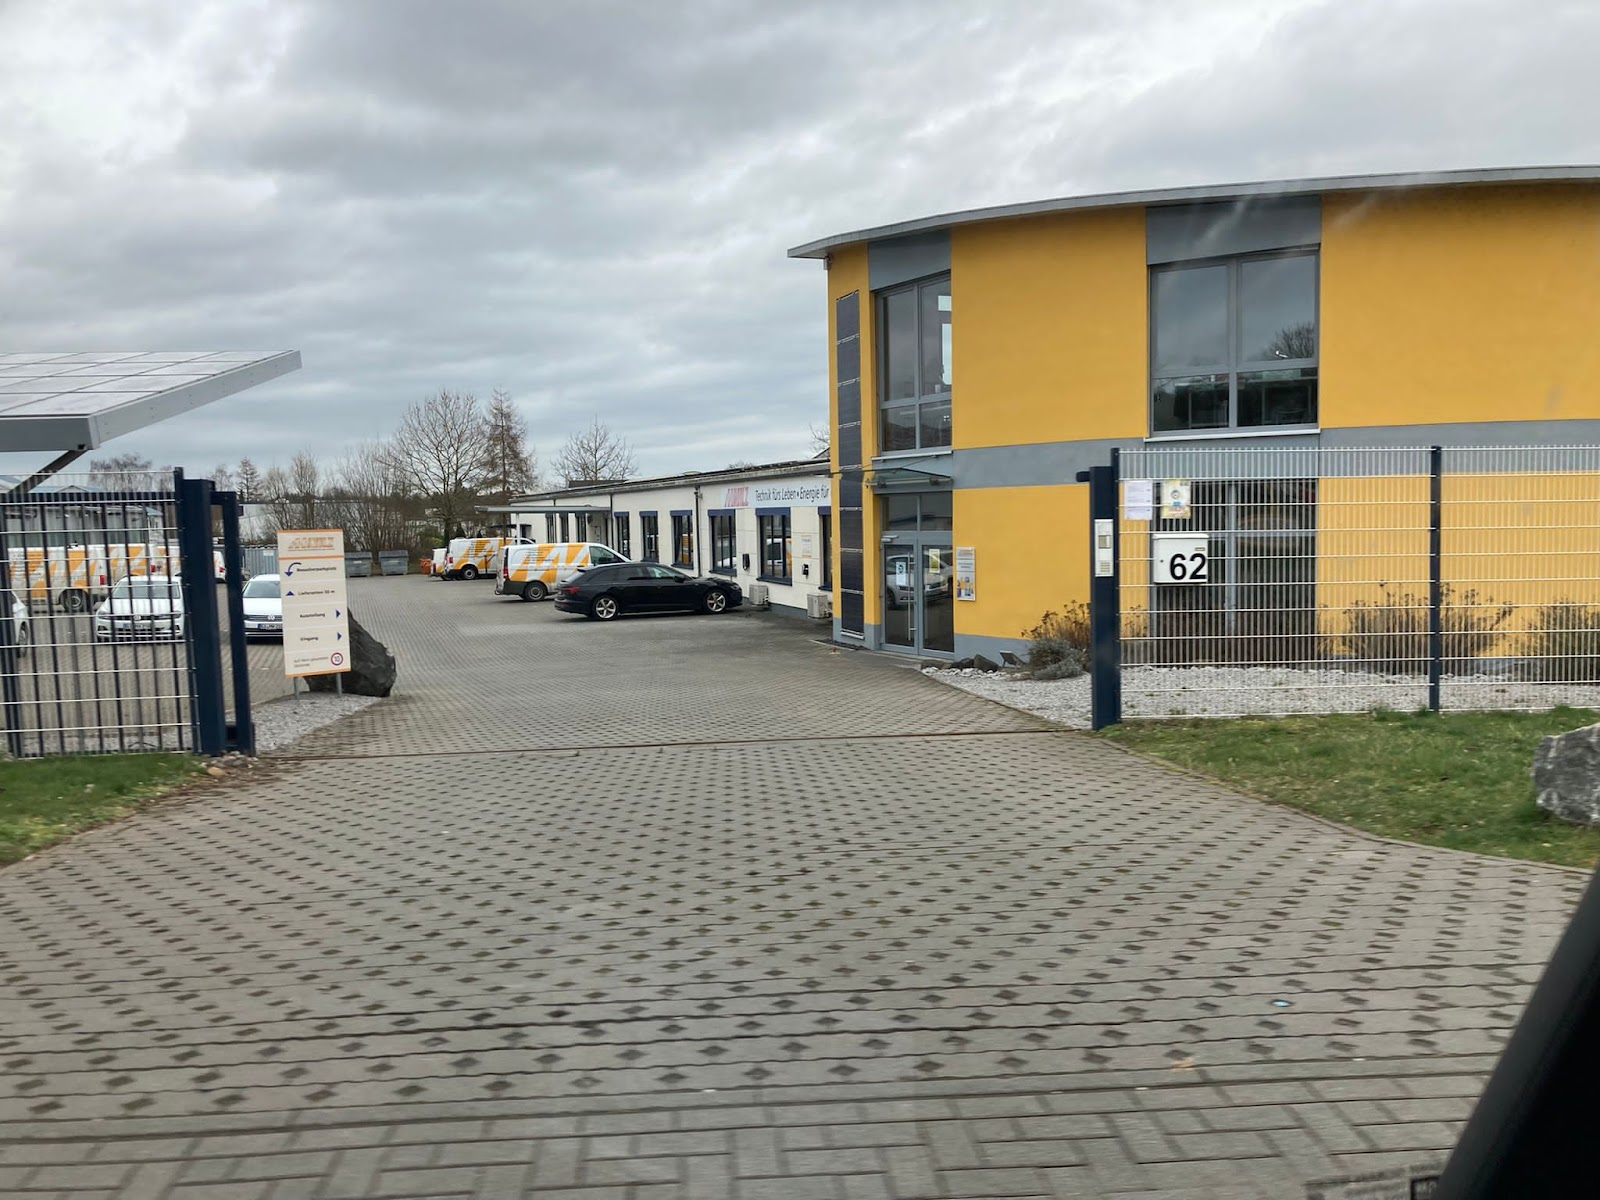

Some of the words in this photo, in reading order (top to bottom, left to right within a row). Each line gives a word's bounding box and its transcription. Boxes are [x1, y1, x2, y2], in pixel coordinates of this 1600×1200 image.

[755, 488, 771, 501] Technik
[772, 487, 781, 501] fürs
[782, 487, 796, 500] Leben
[800, 485, 820, 503] Energie
[820, 484, 830, 499] für
[1169, 552, 1207, 581] 62
[334, 655, 341, 663] 10
